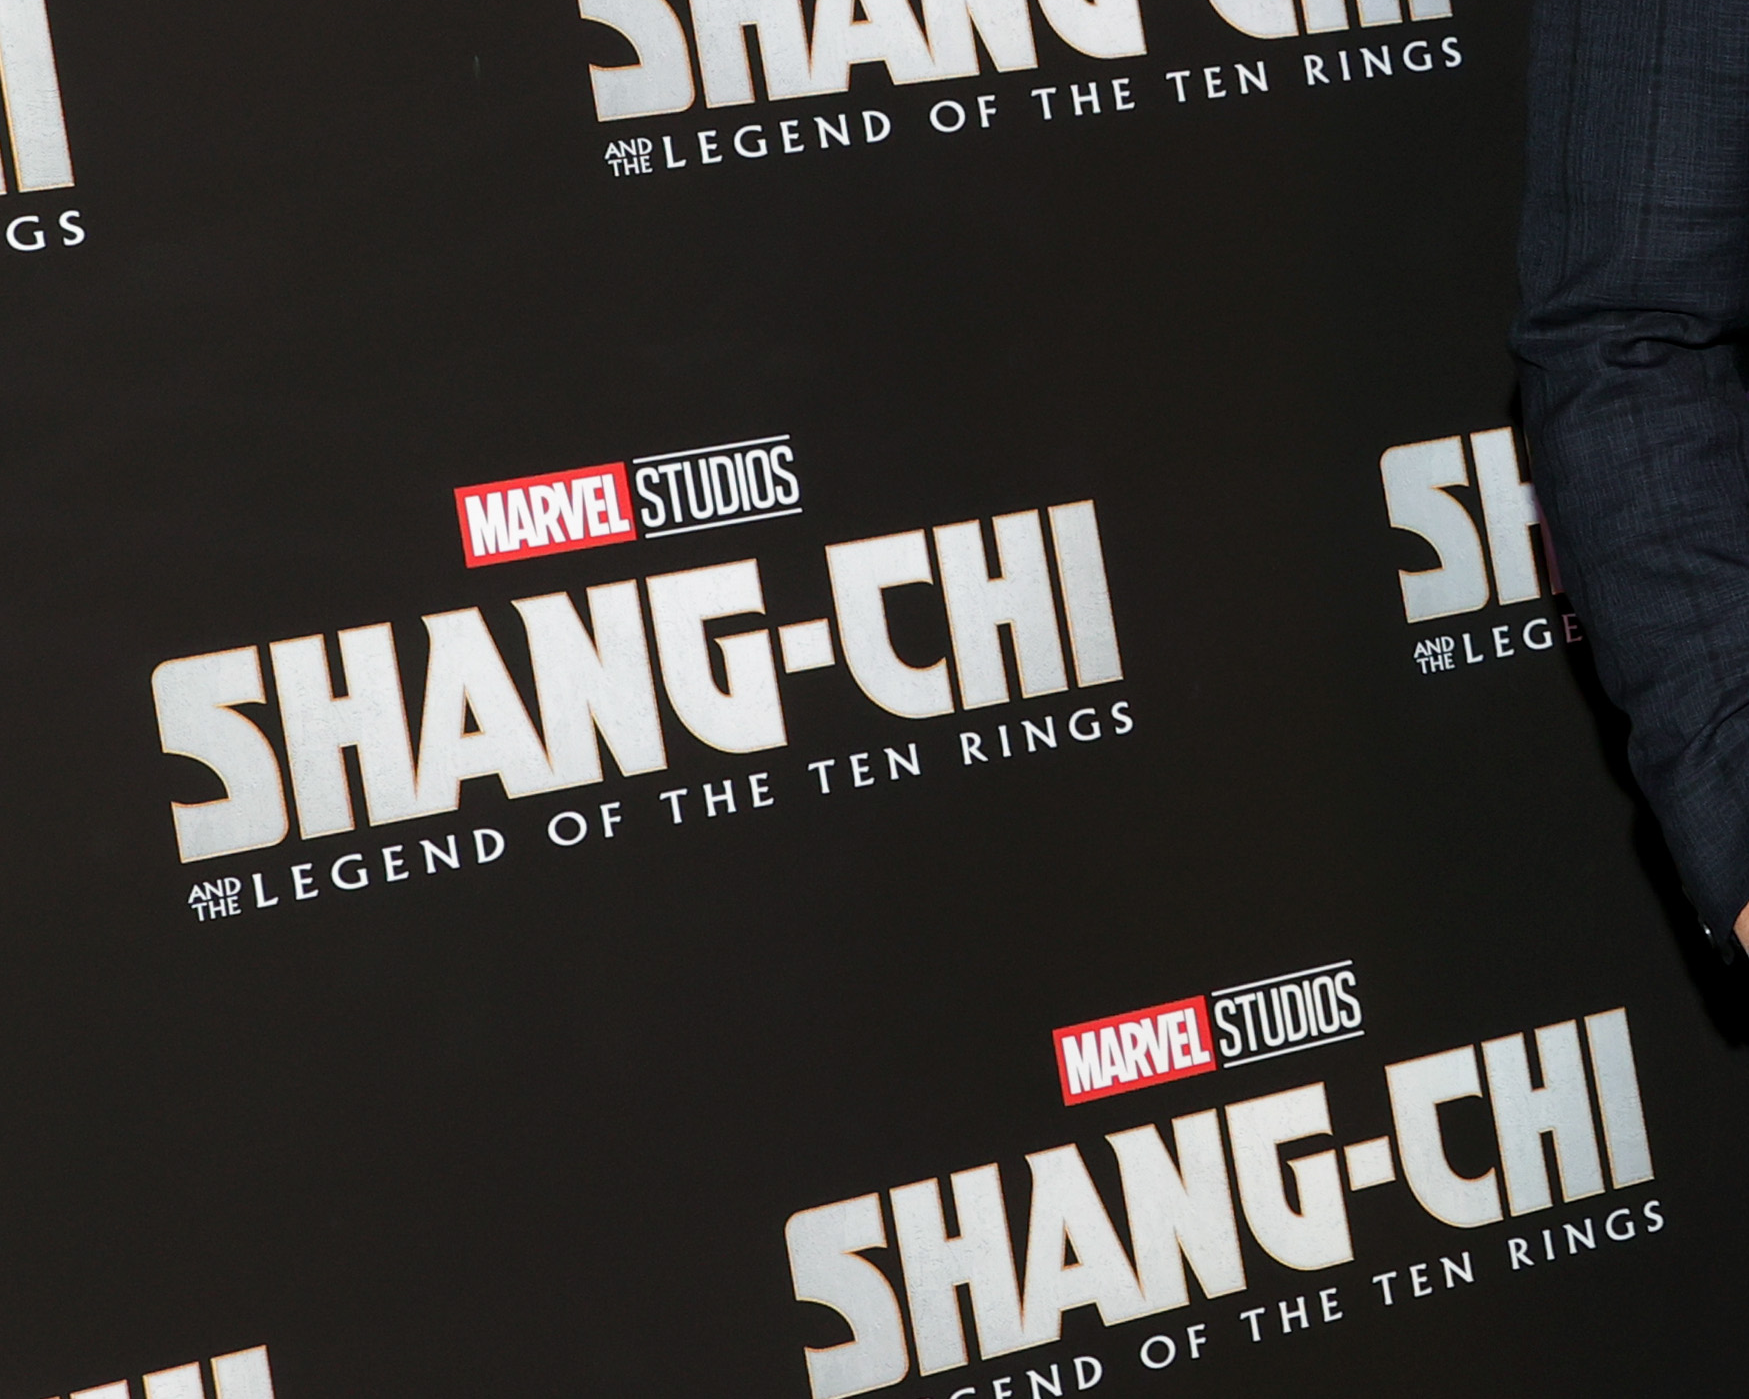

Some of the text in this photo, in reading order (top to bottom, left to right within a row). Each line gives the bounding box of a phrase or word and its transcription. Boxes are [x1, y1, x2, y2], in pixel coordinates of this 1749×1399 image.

[605, 138, 652, 159] AND
[663, 37, 1461, 168] LEGEND OF THE TEN RINGS
[608, 155, 652, 176] THE
[465, 445, 799, 556] MARVEL STUDIOS
[151, 500, 1123, 863] SHANG-CHI
[1413, 636, 1455, 659] AND
[1416, 653, 1455, 674] THE
[252, 702, 1133, 908] LEGEND OF THE TEN RINGS
[188, 877, 241, 903] AND
[191, 896, 241, 921] THE
[1062, 971, 1361, 1094] MARVEL STUDIOS
[785, 1008, 1654, 1399] SHANG-CHI
[1140, 1324, 1206, 1368] OF
[1240, 1288, 1342, 1341] THE
[1373, 1252, 1473, 1305] TEN
[1508, 1201, 1663, 1269] RINGS
